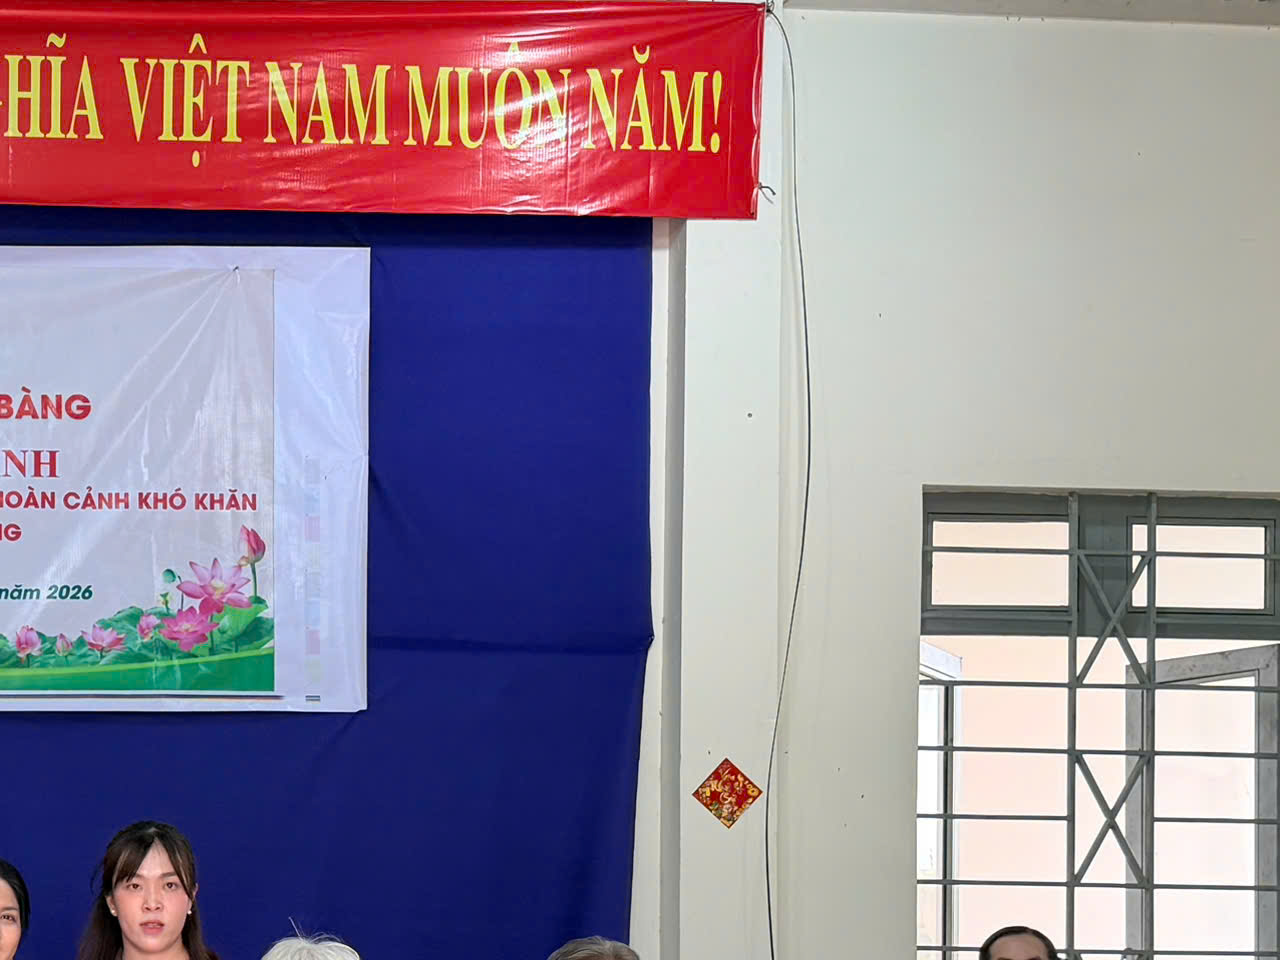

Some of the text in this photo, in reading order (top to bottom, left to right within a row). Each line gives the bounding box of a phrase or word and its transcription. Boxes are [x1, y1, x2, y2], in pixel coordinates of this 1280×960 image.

[120, 34, 249, 167] VIỆT
[265, 62, 390, 144] NAM
[404, 42, 571, 149] MUÔN
[586, 44, 723, 152] NĂM!
[64, 488, 130, 511] CẢNH
[138, 489, 187, 512] KHÓ
[194, 488, 257, 512] KHĂN
[47, 585, 93, 600] 2026
